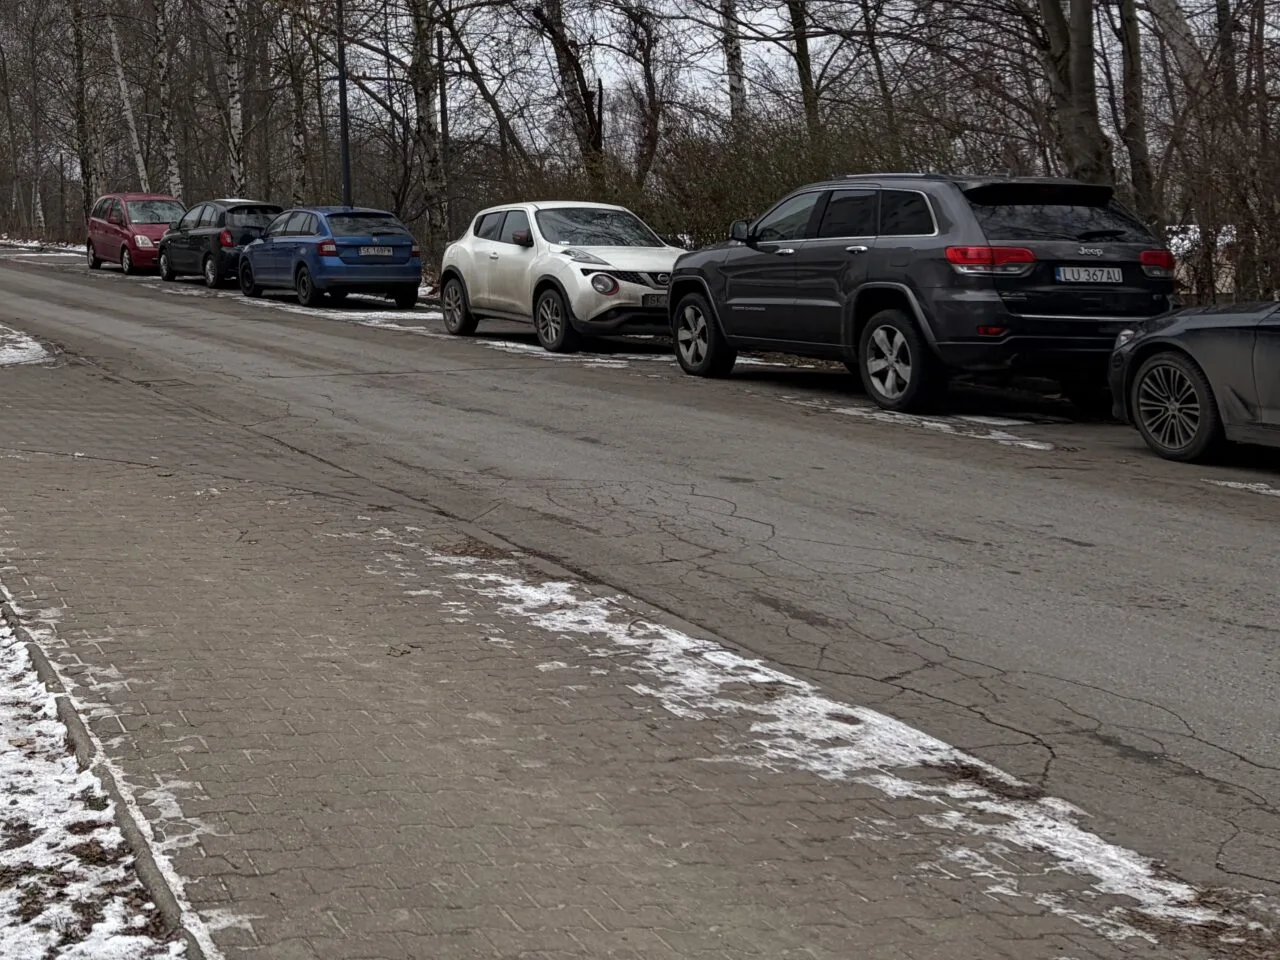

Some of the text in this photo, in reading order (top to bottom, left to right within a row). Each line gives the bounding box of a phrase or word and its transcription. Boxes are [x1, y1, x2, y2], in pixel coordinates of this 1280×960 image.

[1079, 246, 1103, 256] Jeep
[1063, 268, 1121, 282] LU 367AU
